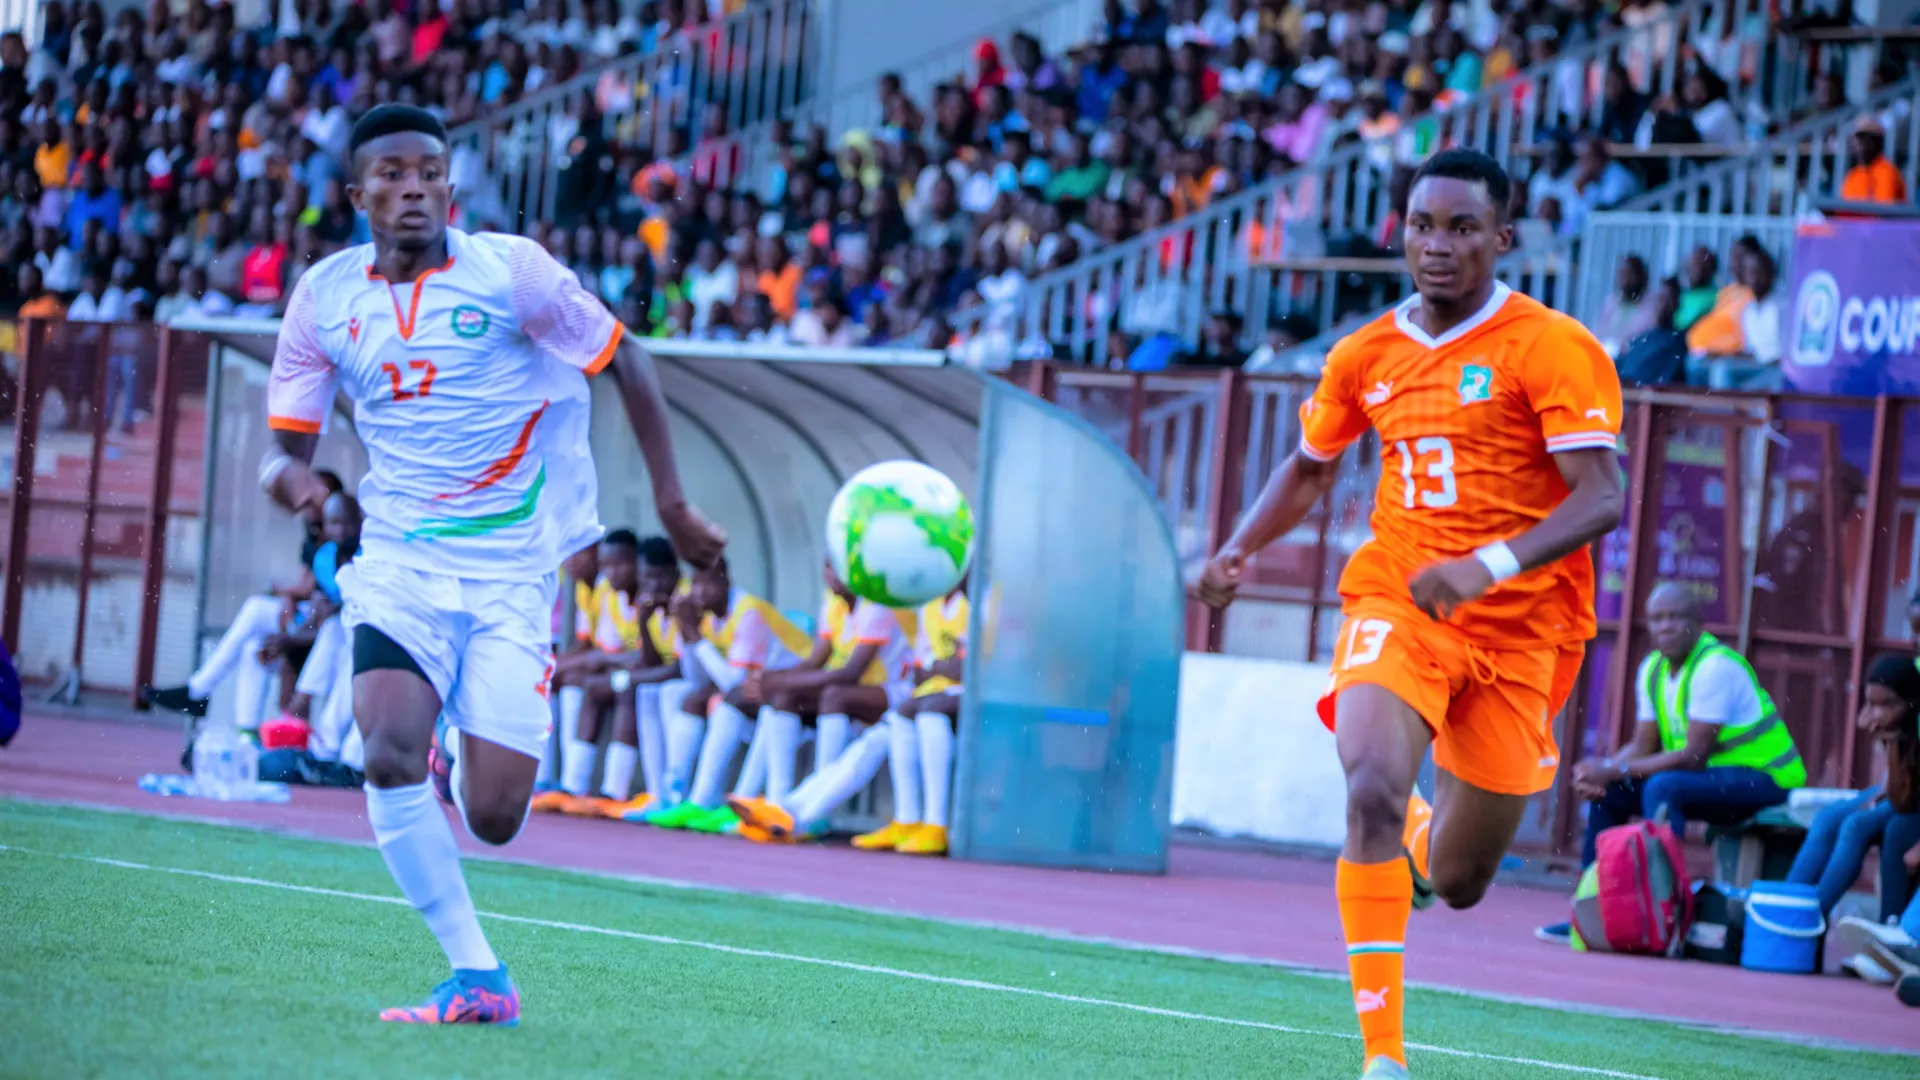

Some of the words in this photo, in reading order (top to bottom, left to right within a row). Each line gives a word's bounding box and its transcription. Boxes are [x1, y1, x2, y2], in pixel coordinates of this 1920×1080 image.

[381, 359, 438, 402] 27
[1396, 436, 1458, 509] 13
[1342, 617, 1393, 671] 13
